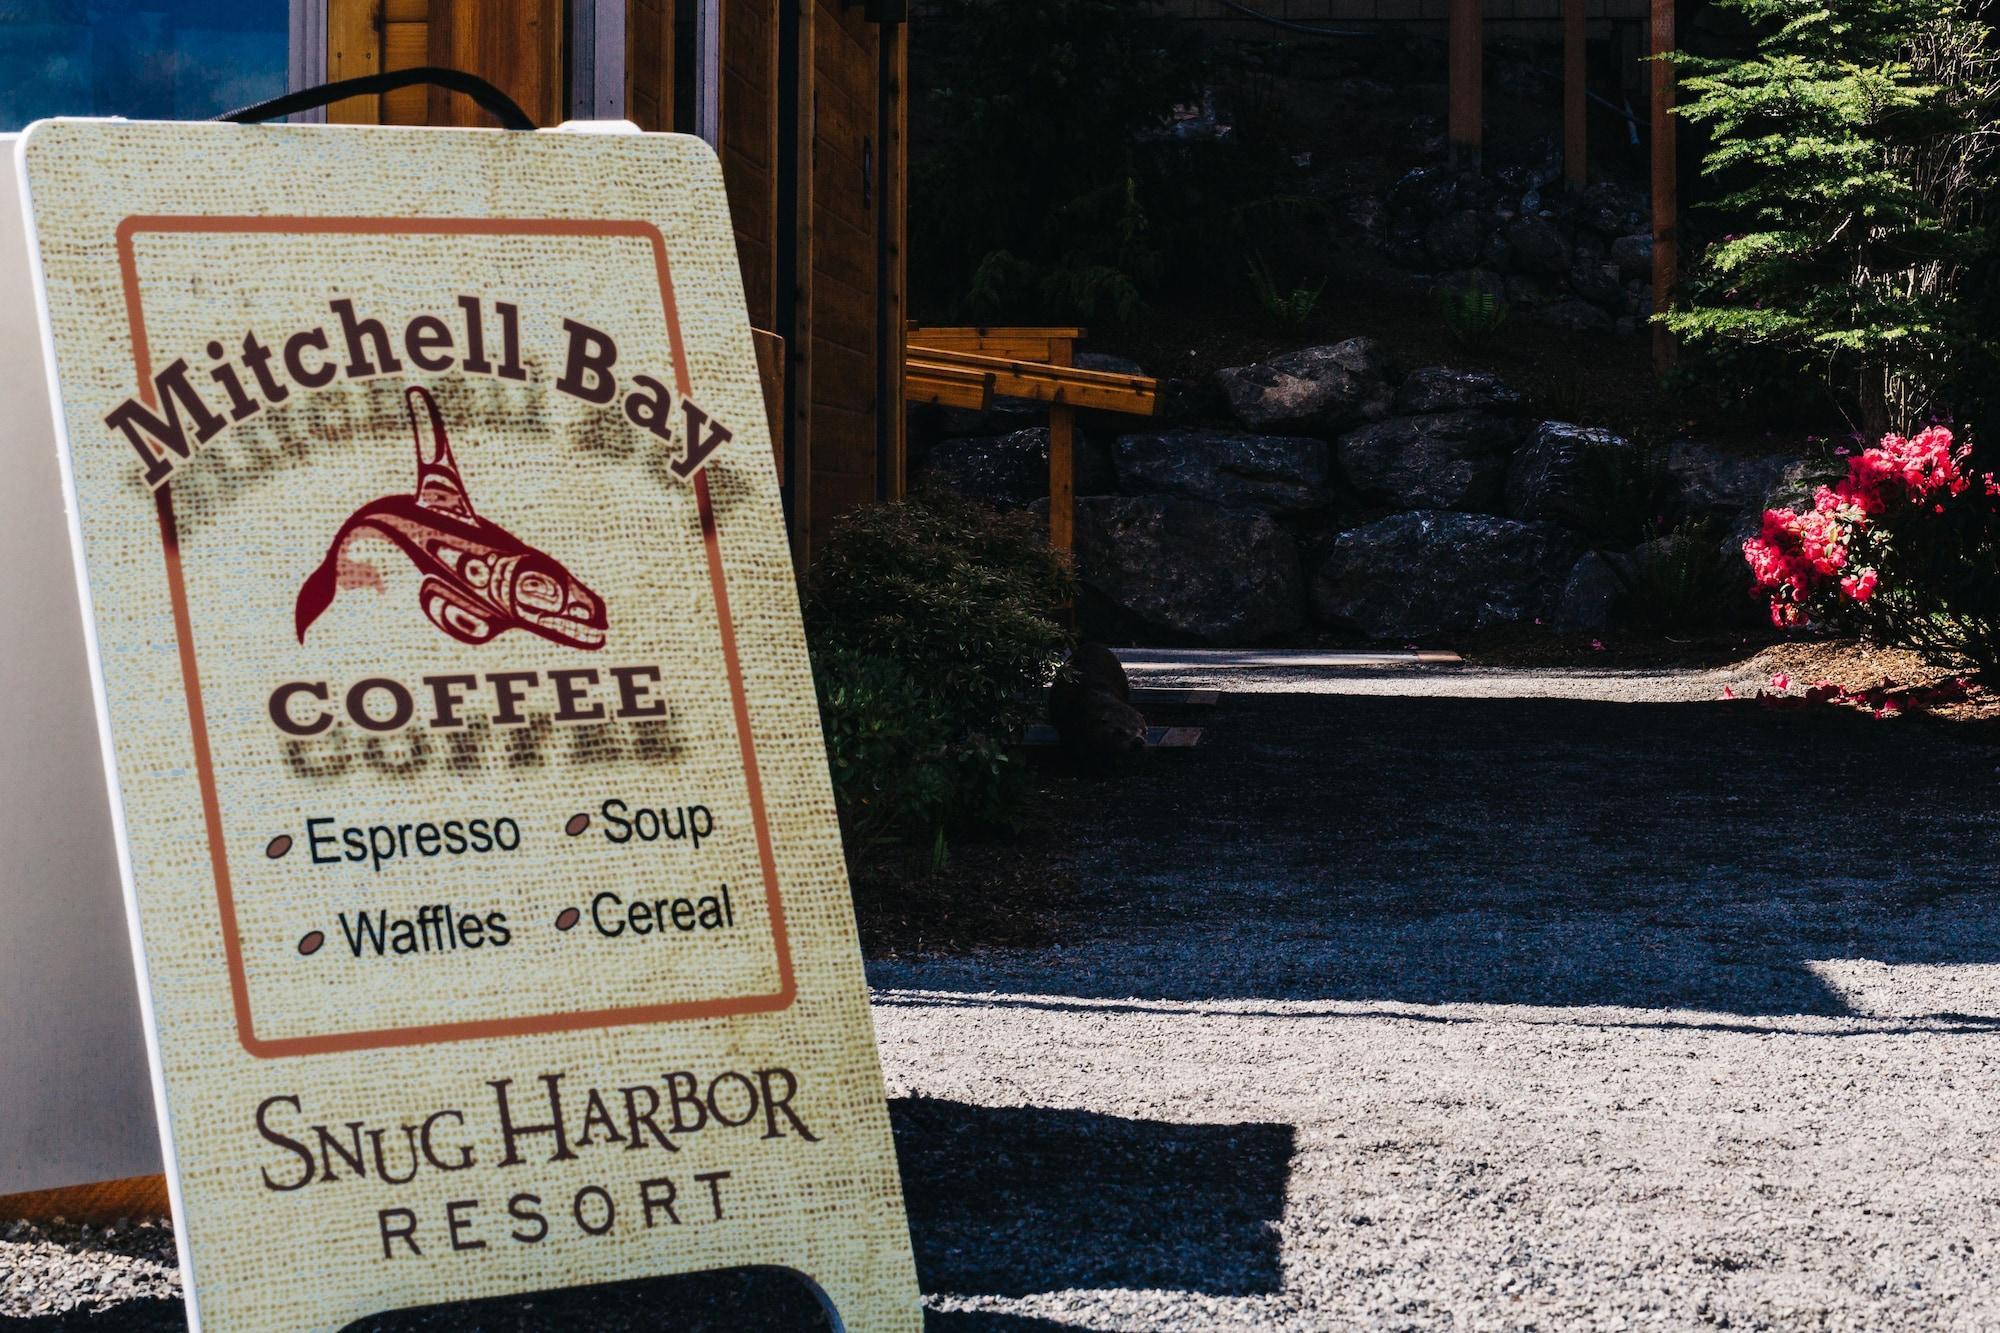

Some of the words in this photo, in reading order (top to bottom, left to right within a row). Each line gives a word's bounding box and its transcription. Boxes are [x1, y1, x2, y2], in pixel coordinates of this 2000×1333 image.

[105, 295, 528, 487] Mitchell
[555, 318, 733, 479] Bay
[268, 665, 668, 736] COFFEE
[306, 815, 521, 872] Espresso
[601, 798, 714, 849] Soup
[339, 905, 512, 958] Waffles
[590, 884, 735, 938] Cereal
[255, 1094, 475, 1192] SNUG
[487, 1066, 822, 1168] HARBOR
[378, 1170, 731, 1259] RESORT
